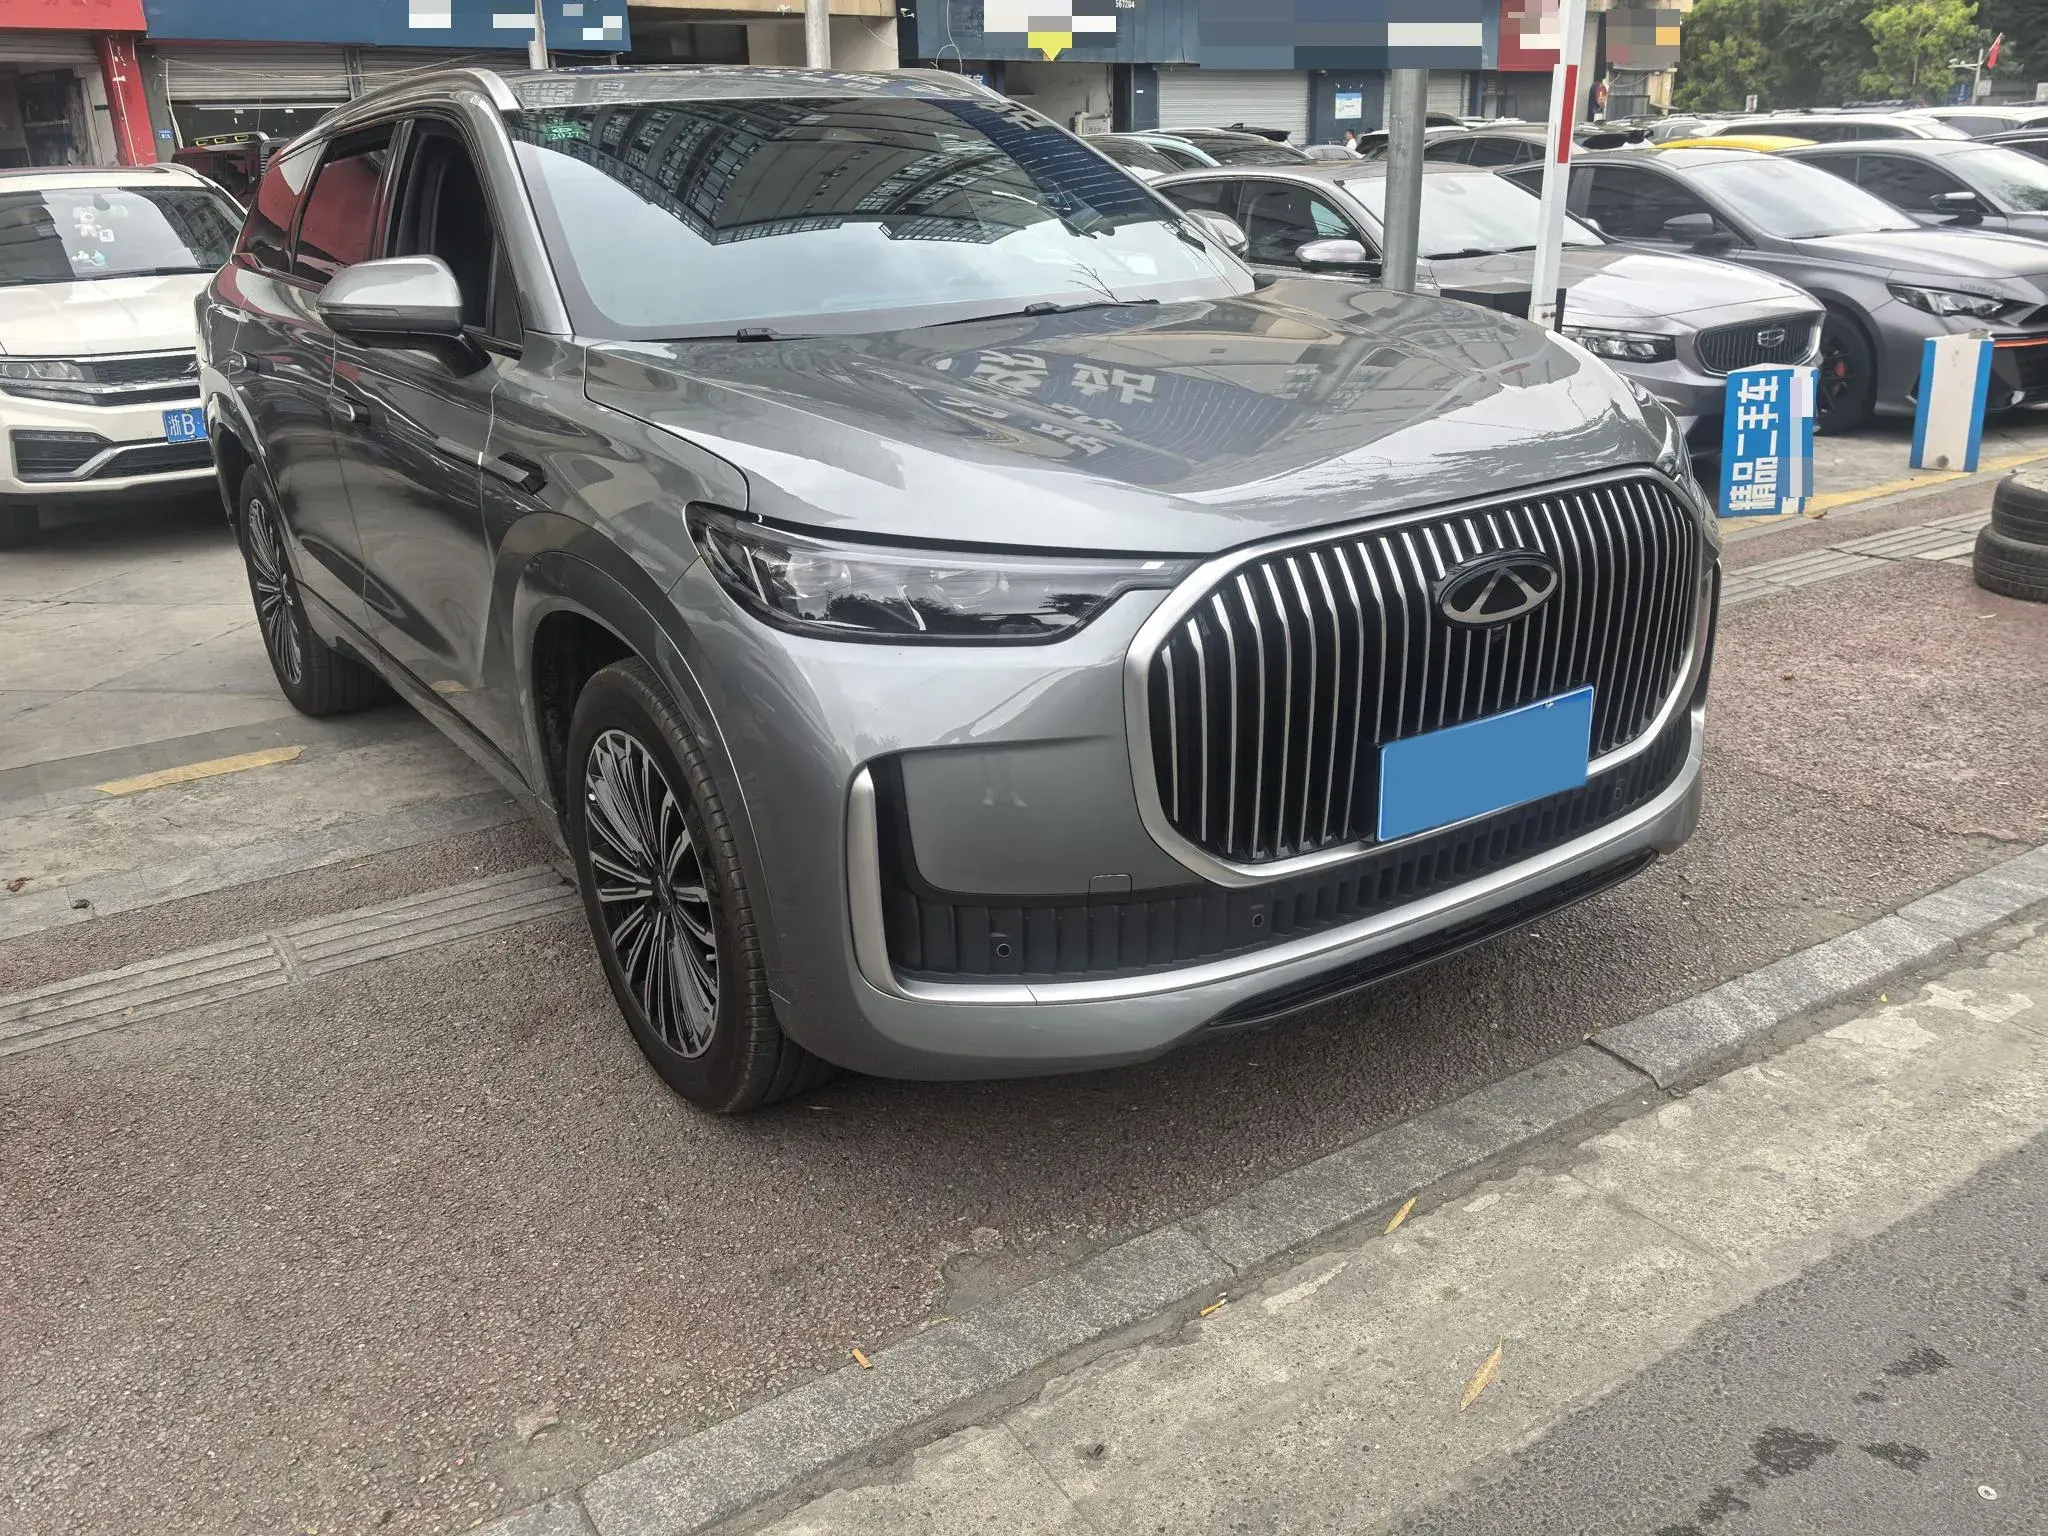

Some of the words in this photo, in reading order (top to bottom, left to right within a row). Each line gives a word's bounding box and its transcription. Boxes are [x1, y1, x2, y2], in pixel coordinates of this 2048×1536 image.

[1729, 375, 1779, 511] 精品二手车
